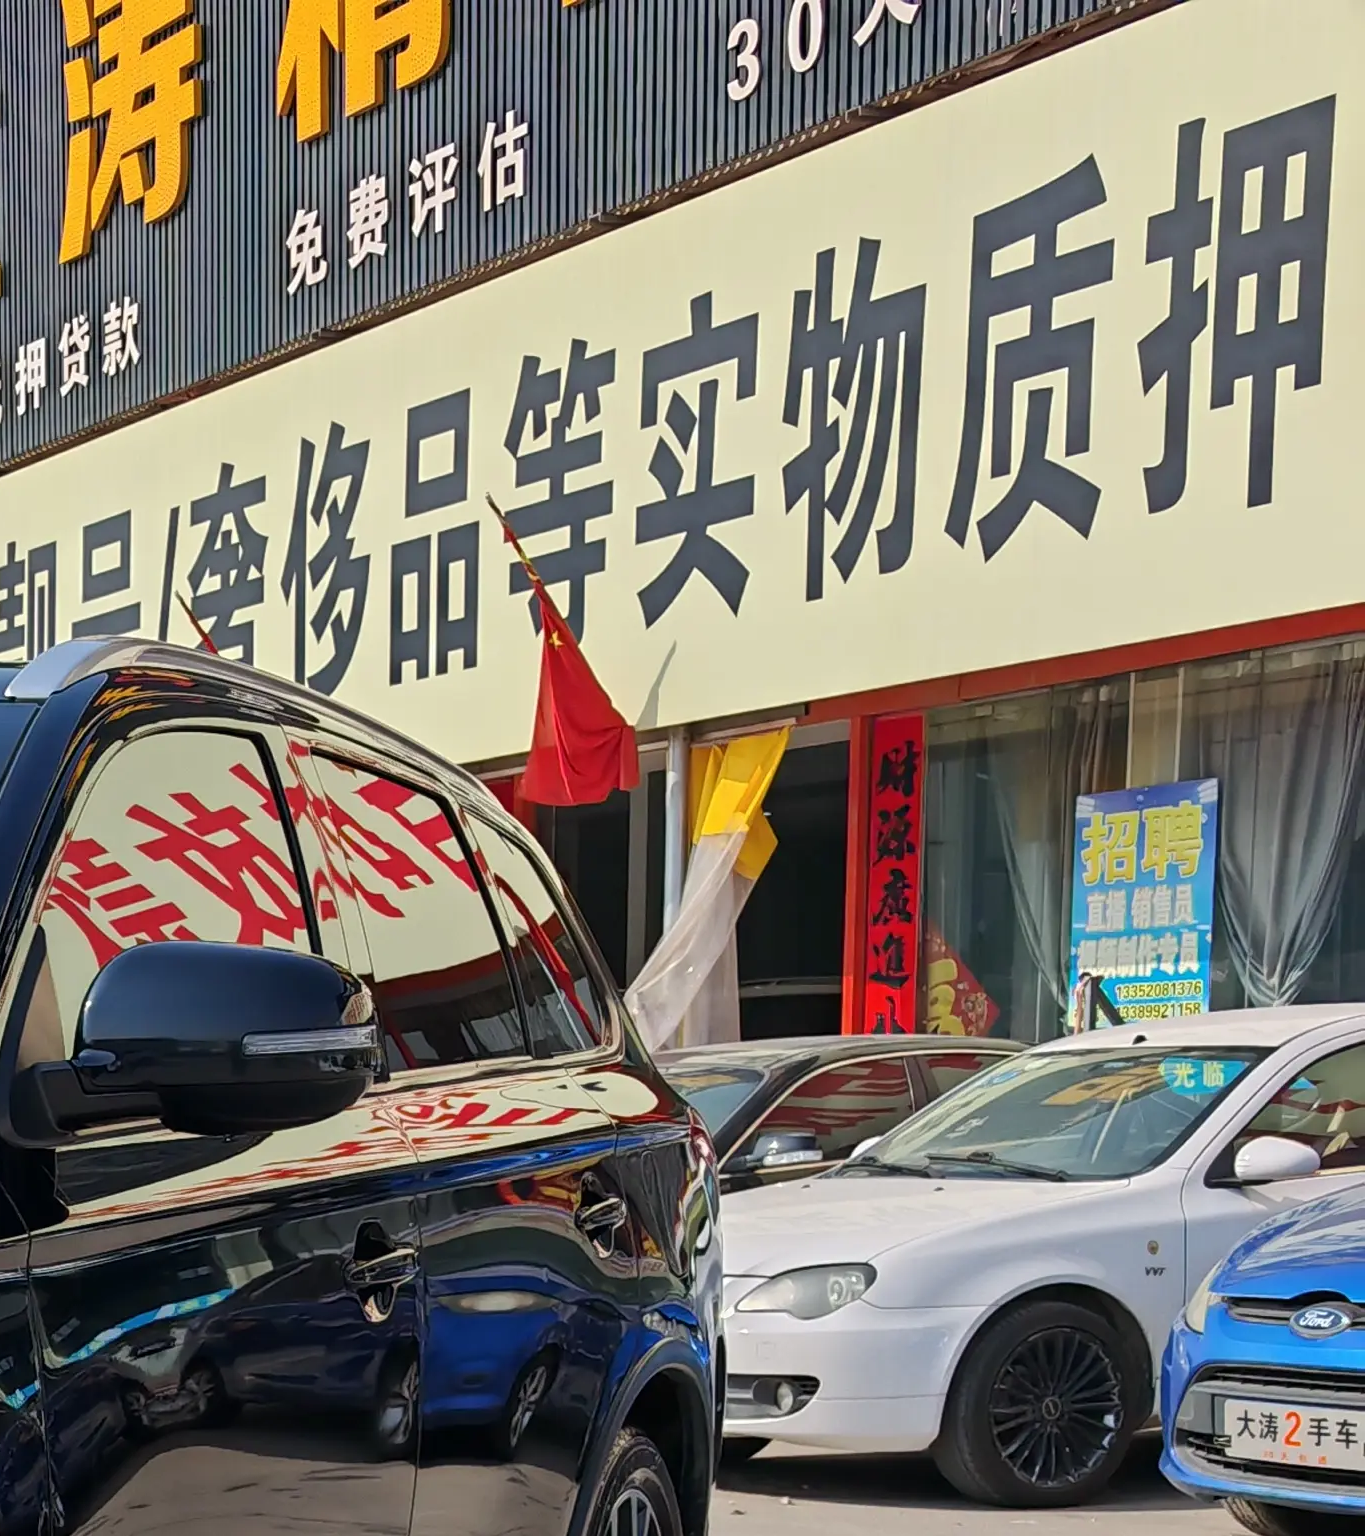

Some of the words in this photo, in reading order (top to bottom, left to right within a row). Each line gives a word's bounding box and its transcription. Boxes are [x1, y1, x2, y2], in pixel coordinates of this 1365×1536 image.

[286, 109, 530, 296] 免费评估
[1081, 800, 1203, 886] 招聘
[1131, 883, 1195, 930] 销售员
[1116, 981, 1202, 999] 13352081376
[1298, 1307, 1336, 1330] Ford
[1236, 1409, 1359, 1450] 大涛2手车
